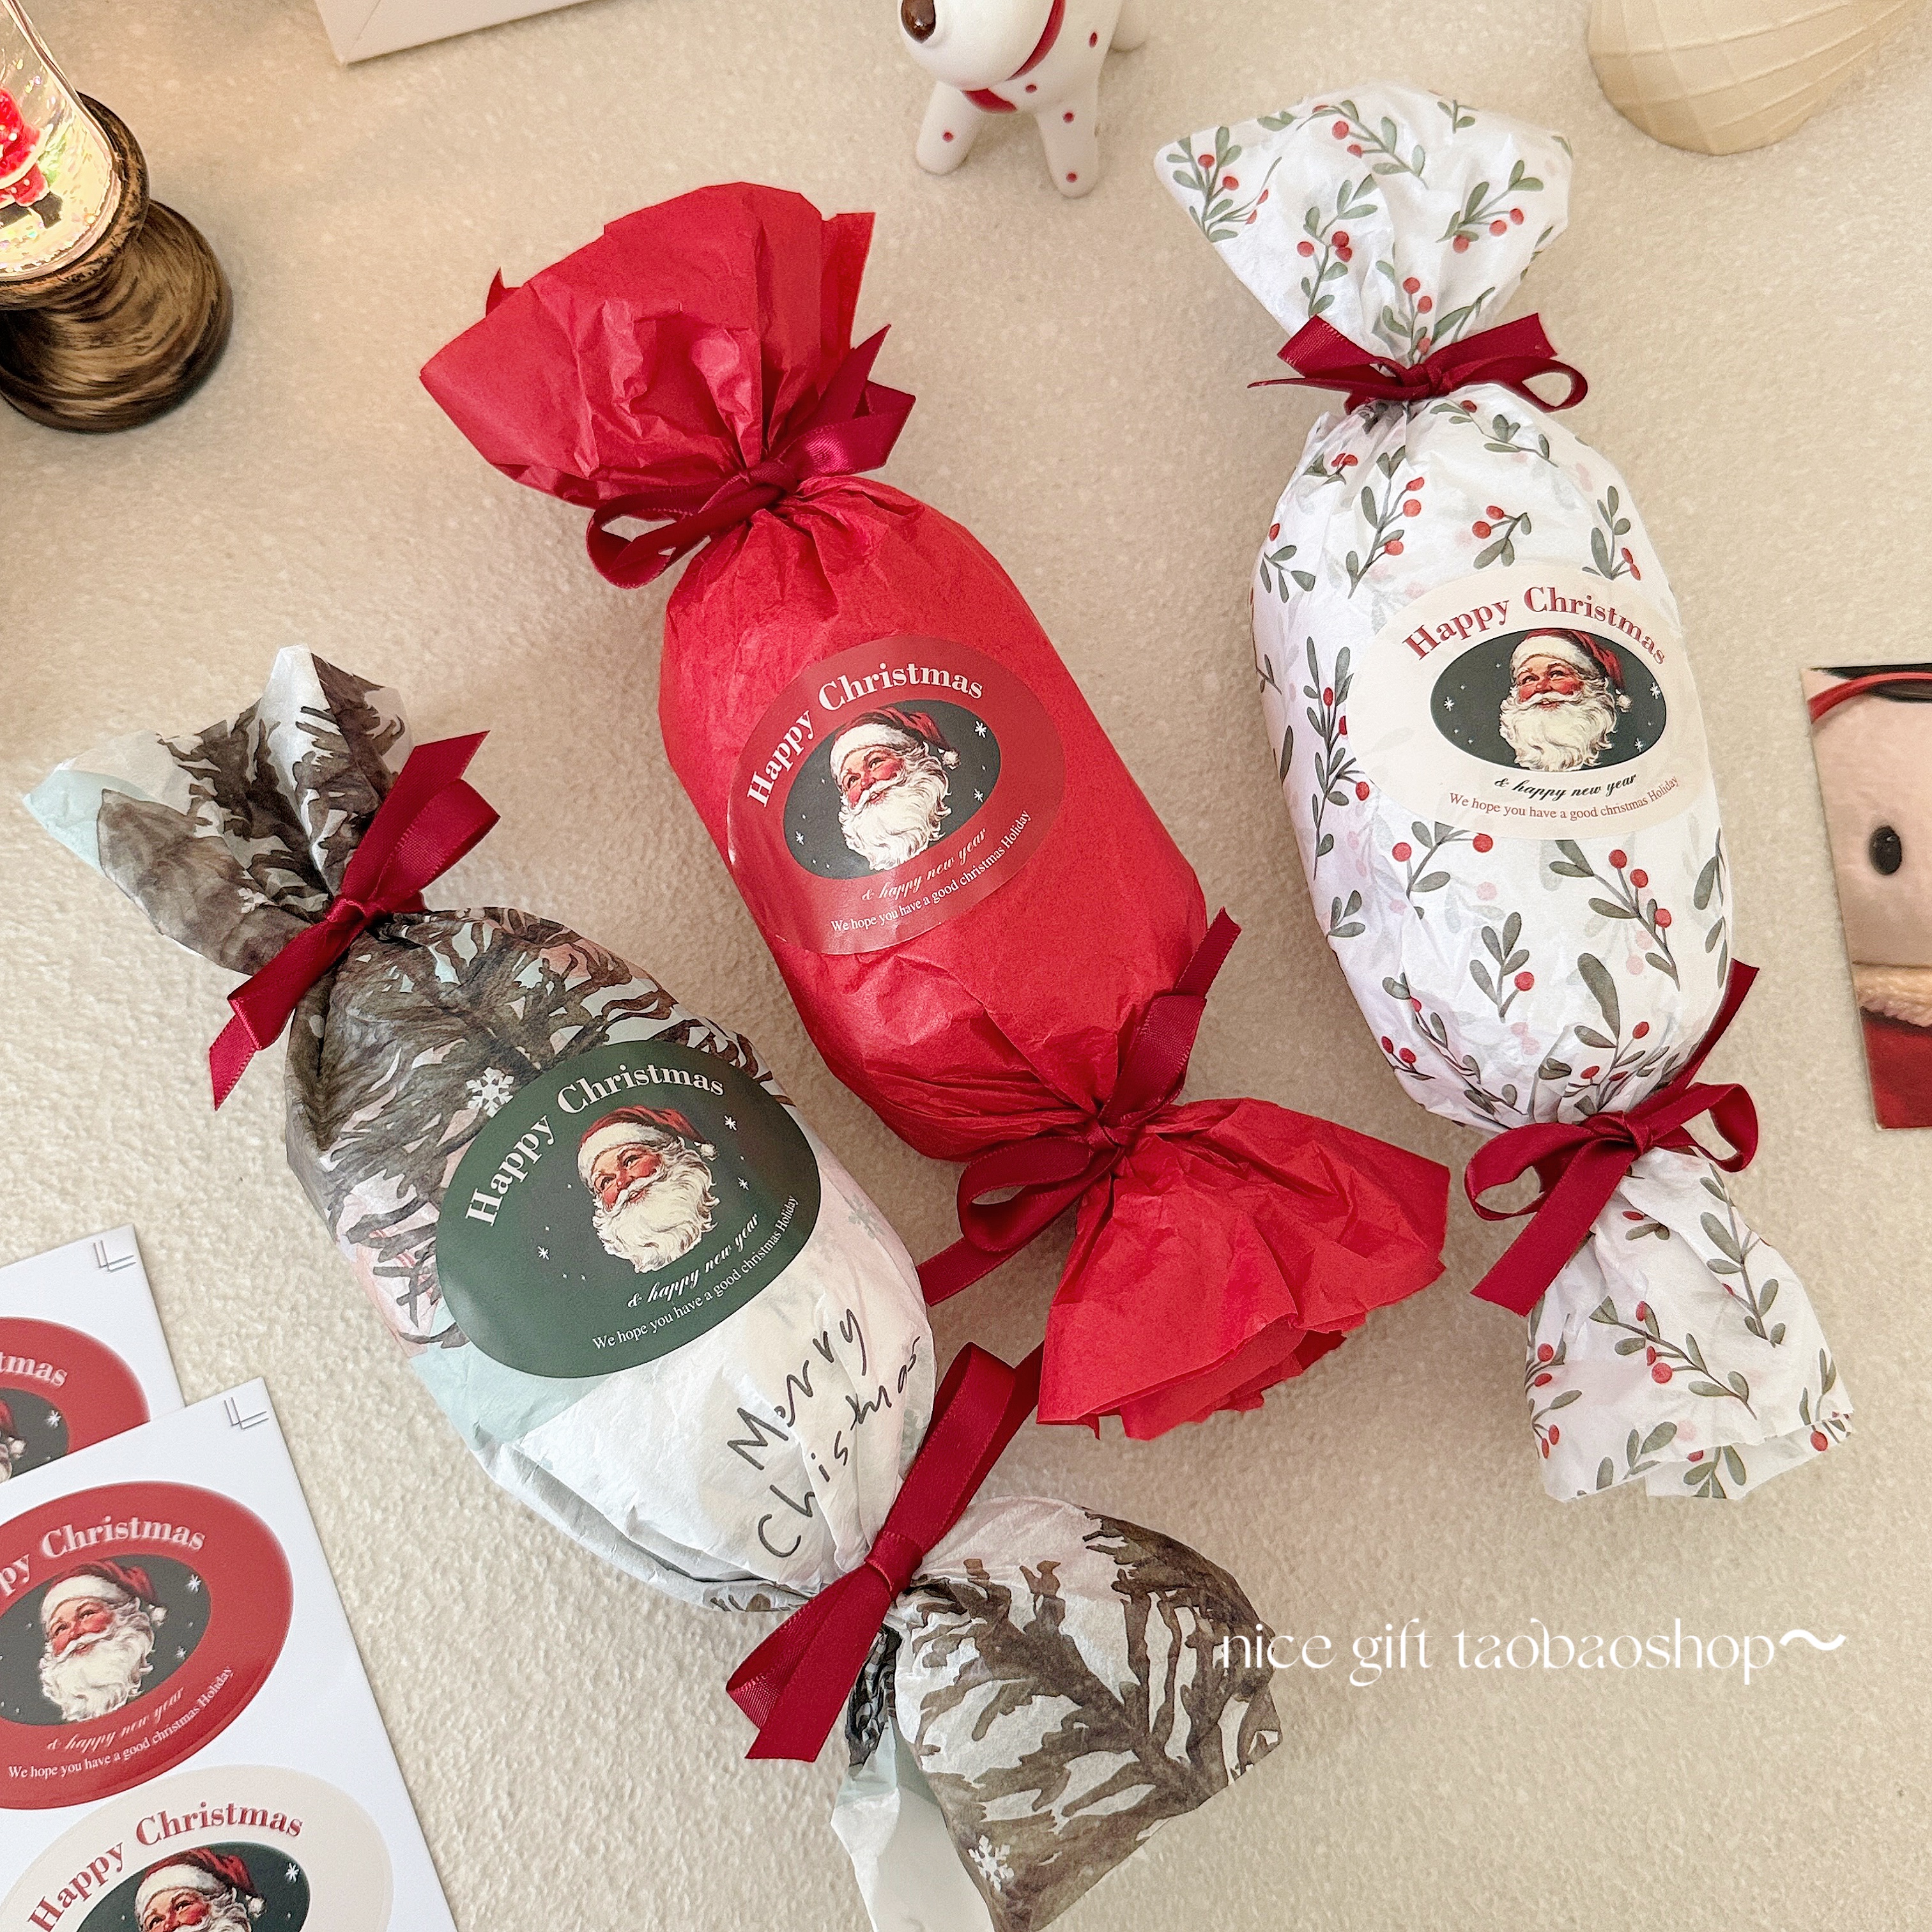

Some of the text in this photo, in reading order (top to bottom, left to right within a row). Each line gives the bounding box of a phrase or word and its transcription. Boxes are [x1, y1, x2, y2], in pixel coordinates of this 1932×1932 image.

[1401, 586, 1666, 665] Happy Christmas
[746, 663, 984, 808] Happy Christmas
[1449, 776, 1680, 821] We hope you have a good christmas Holiday
[1512, 779, 1566, 801] happy
[1570, 786, 1601, 797] new
[1606, 773, 1637, 797] year
[831, 810, 1032, 932] We hope you have a good christmas Holiday
[878, 875, 923, 900] happy
[926, 857, 955, 880] new
[958, 827, 986, 865] year
[464, 1063, 724, 1226] Happy Christmas
[592, 1195, 799, 1349] We hope you have a good christmas Holiday
[647, 1269, 700, 1303] happy
[705, 1245, 732, 1274] new
[735, 1213, 758, 1253] year
[727, 1308, 866, 1471] Merry
[41, 1515, 206, 1559] Christmas
[8, 1666, 234, 1779] We hope you have a good christmas Holiday
[65, 1731, 116, 1753] happy
[121, 1716, 150, 1736] new
[154, 1687, 184, 1724] year
[27, 1802, 303, 1932] Happy Christmas
